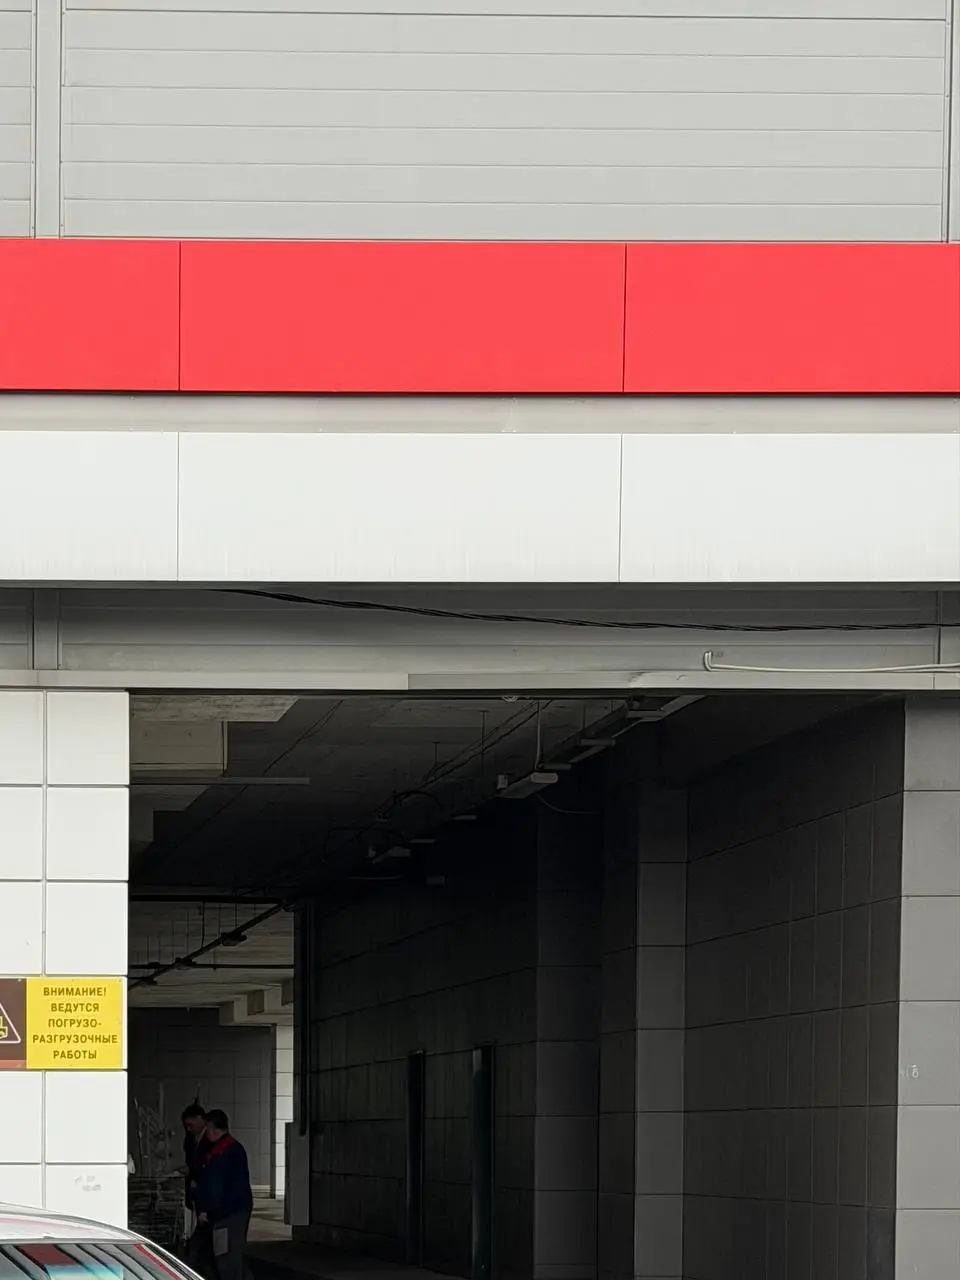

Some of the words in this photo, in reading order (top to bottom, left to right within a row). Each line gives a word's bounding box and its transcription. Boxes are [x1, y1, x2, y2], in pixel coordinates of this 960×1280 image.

[43, 987, 107, 996] ВНИМАНИЕ!
[51, 1003, 100, 1013] ВЕДУТСЯ
[48, 1019, 102, 1028] ПОГРУЗО-
[32, 1034, 118, 1044] РАЗГРУЗОЧНЫЕ
[53, 1050, 97, 1059] РАБОТЫ
